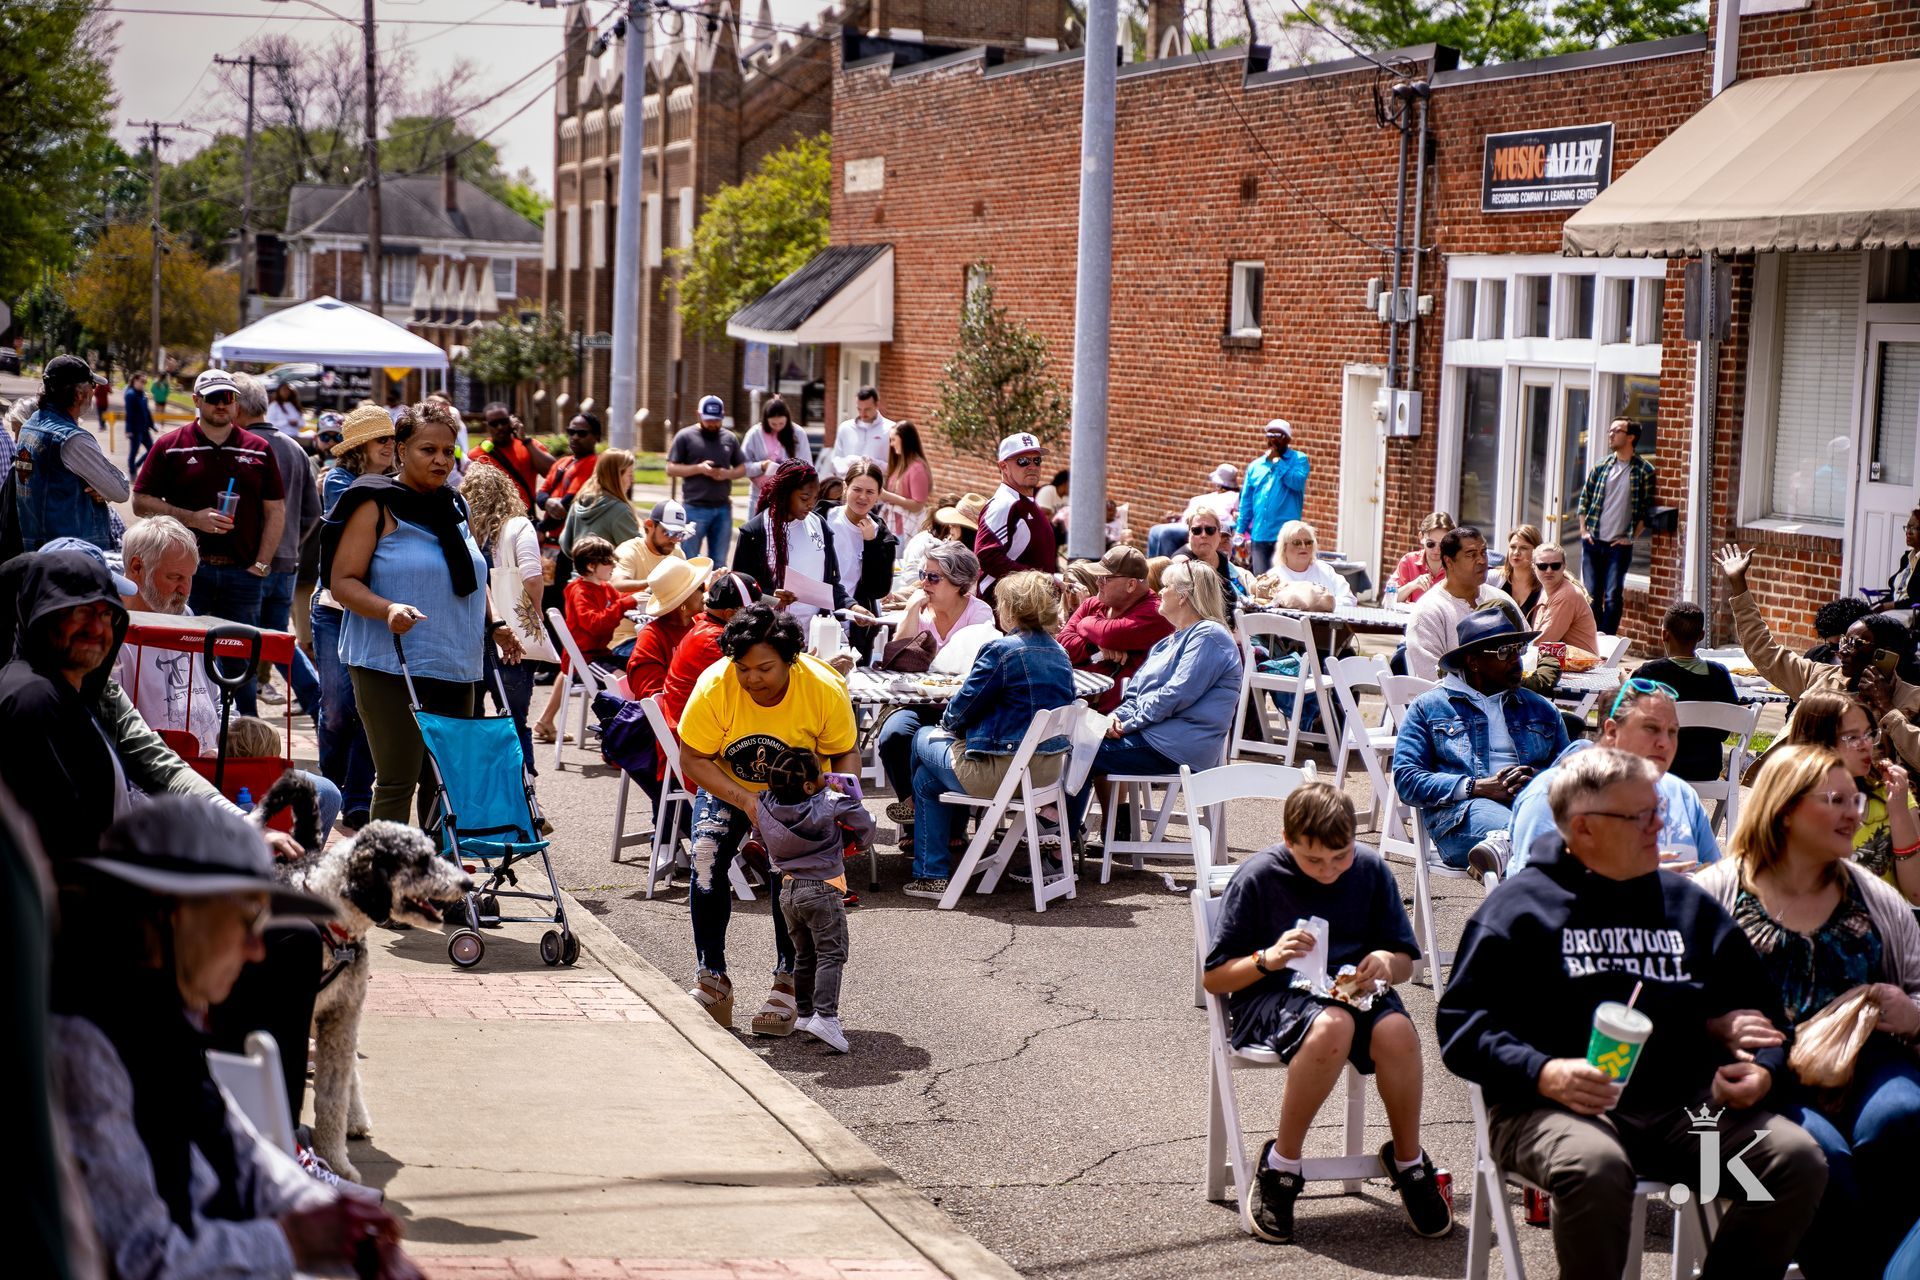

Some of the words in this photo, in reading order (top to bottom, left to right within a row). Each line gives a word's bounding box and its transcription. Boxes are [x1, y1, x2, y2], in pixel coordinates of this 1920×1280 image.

[1492, 144, 1546, 181] MUSIC
[1545, 138, 1603, 178] ALLEY
[1491, 192, 1519, 204] RECORDING
[1520, 190, 1544, 203] COMPANY
[1550, 189, 1575, 201] LEARNING
[1576, 187, 1598, 200] CENTER
[728, 737, 757, 756] COLUMBUS
[1562, 928, 1685, 955] BROOKWOOD
